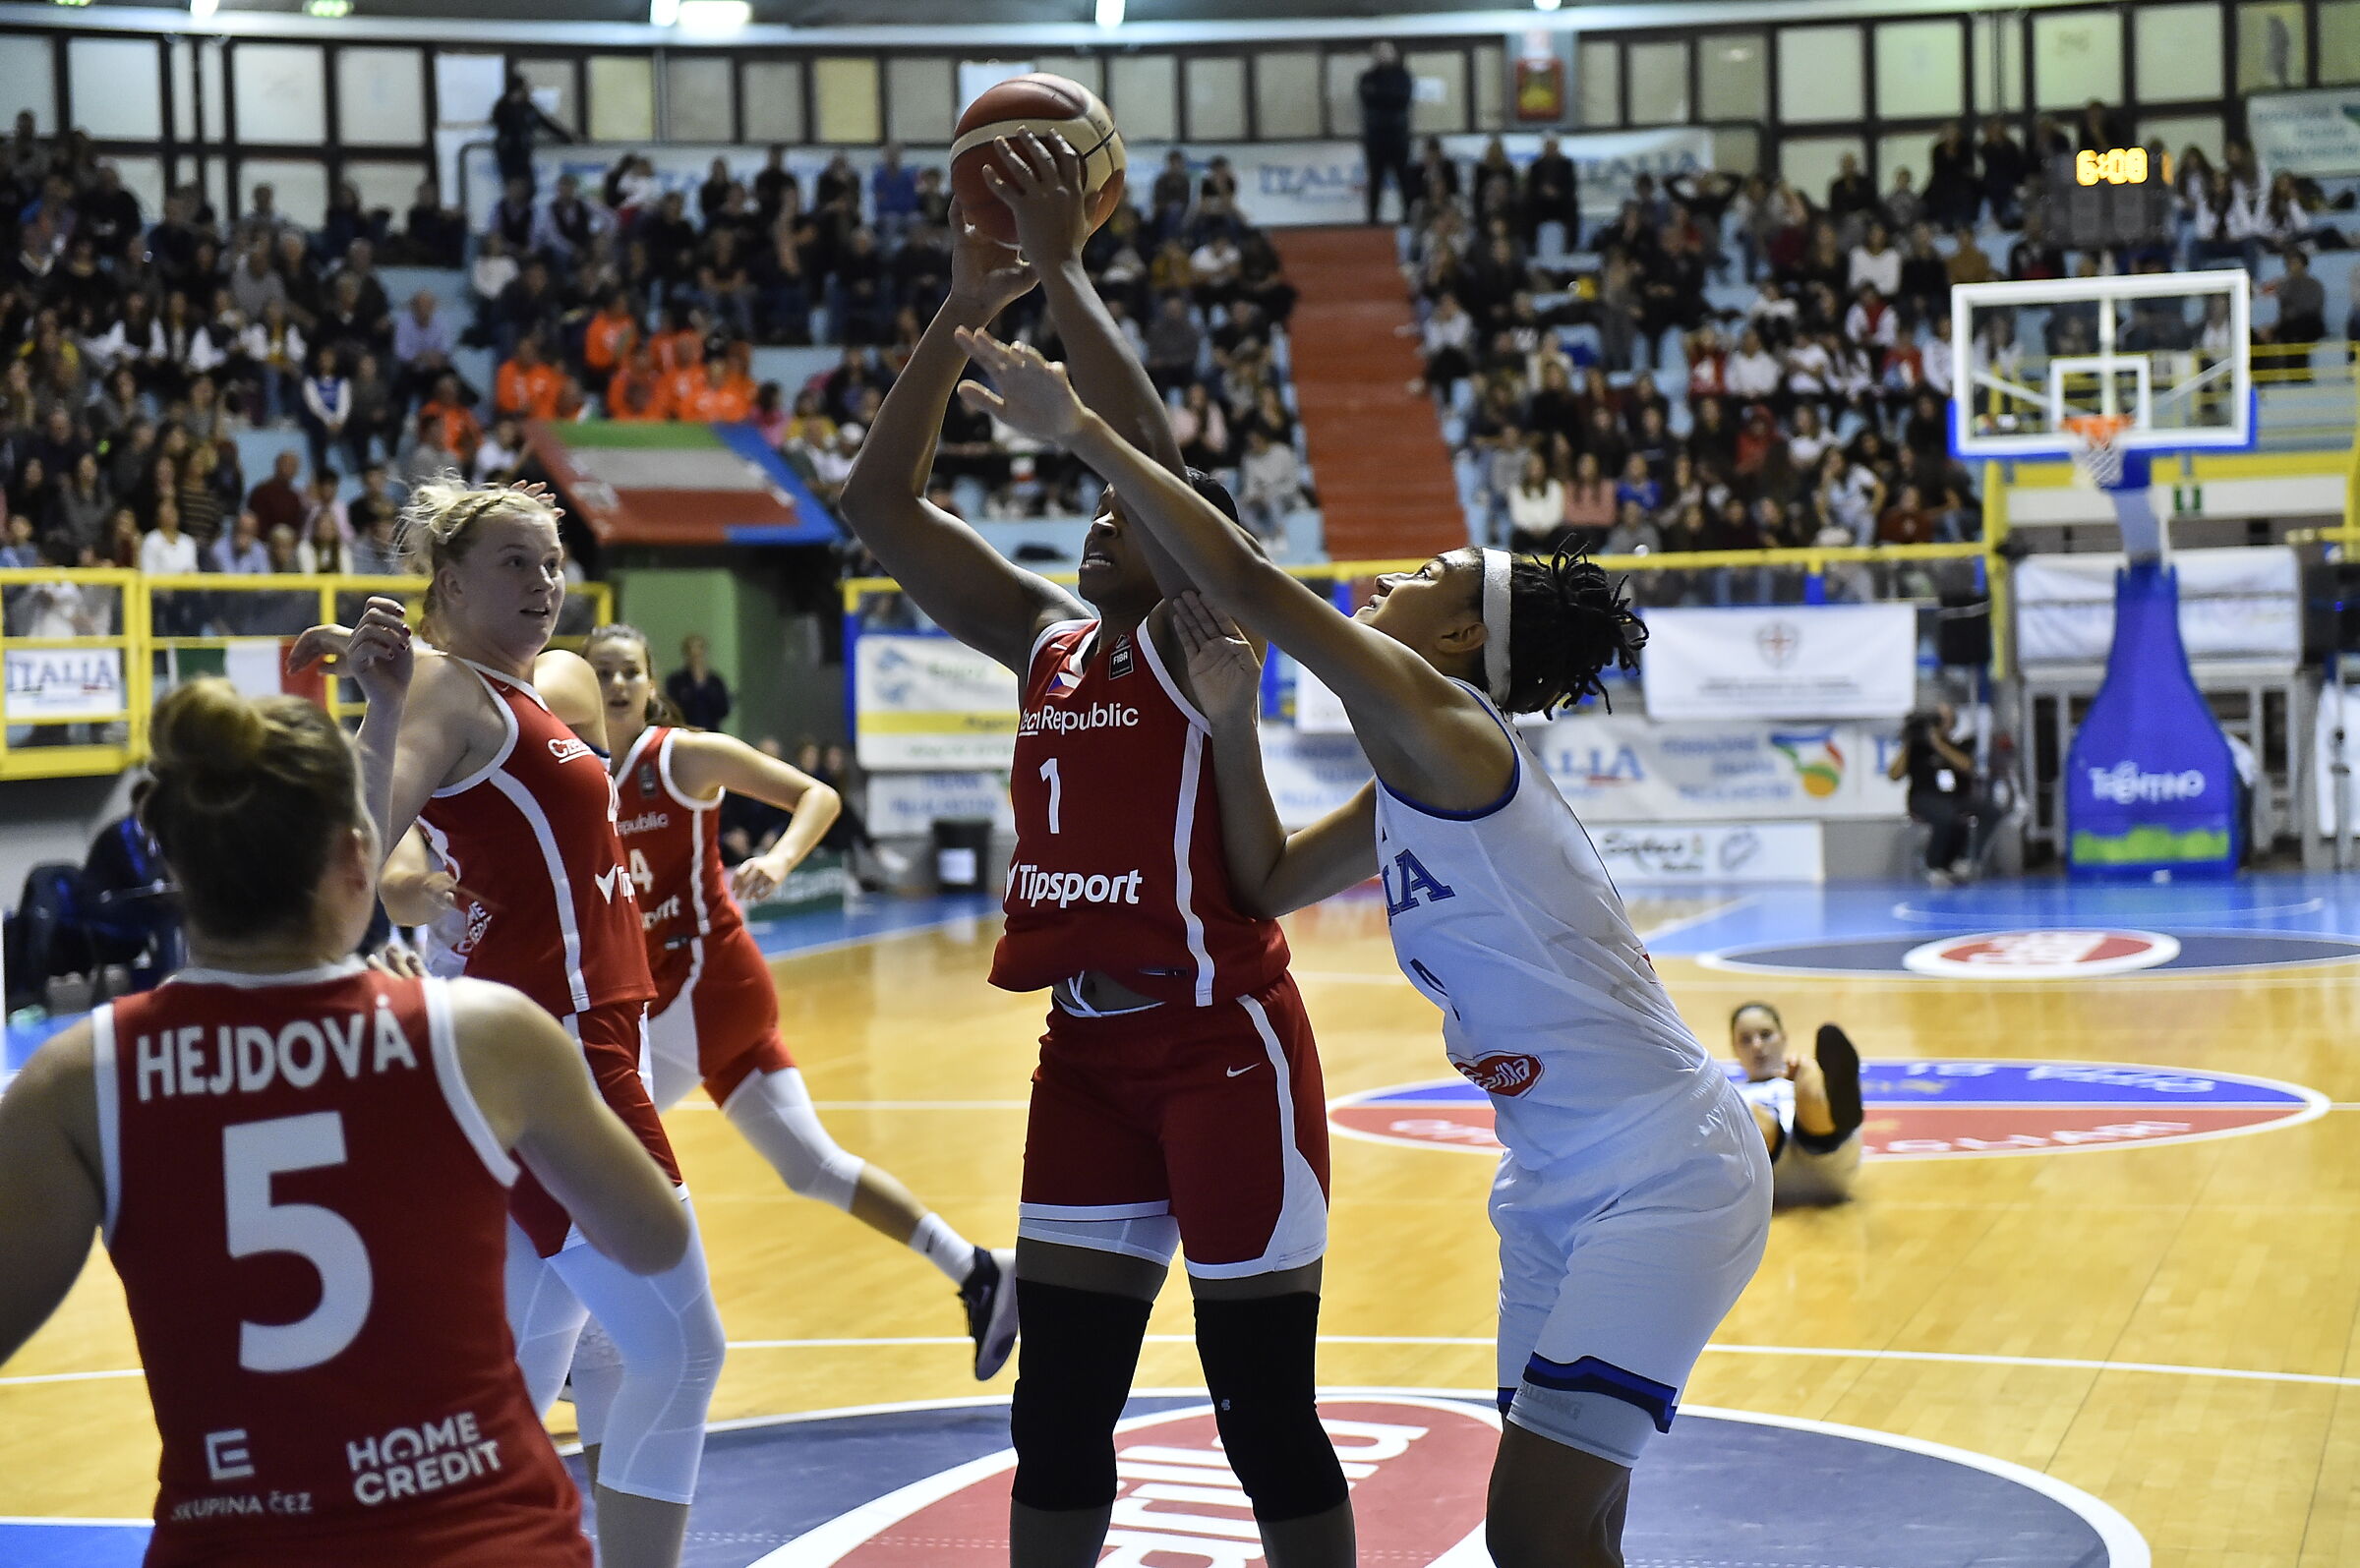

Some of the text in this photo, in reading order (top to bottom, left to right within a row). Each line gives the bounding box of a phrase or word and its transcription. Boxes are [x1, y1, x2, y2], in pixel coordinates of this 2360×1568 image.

[1113, 651, 1128, 665] FIBA
[1039, 758, 1061, 834] 1
[1020, 864, 1143, 908] Tipsport
[222, 1111, 374, 1372] 5
[347, 1412, 481, 1473] HOME
[353, 1440, 502, 1507] CREDIT
